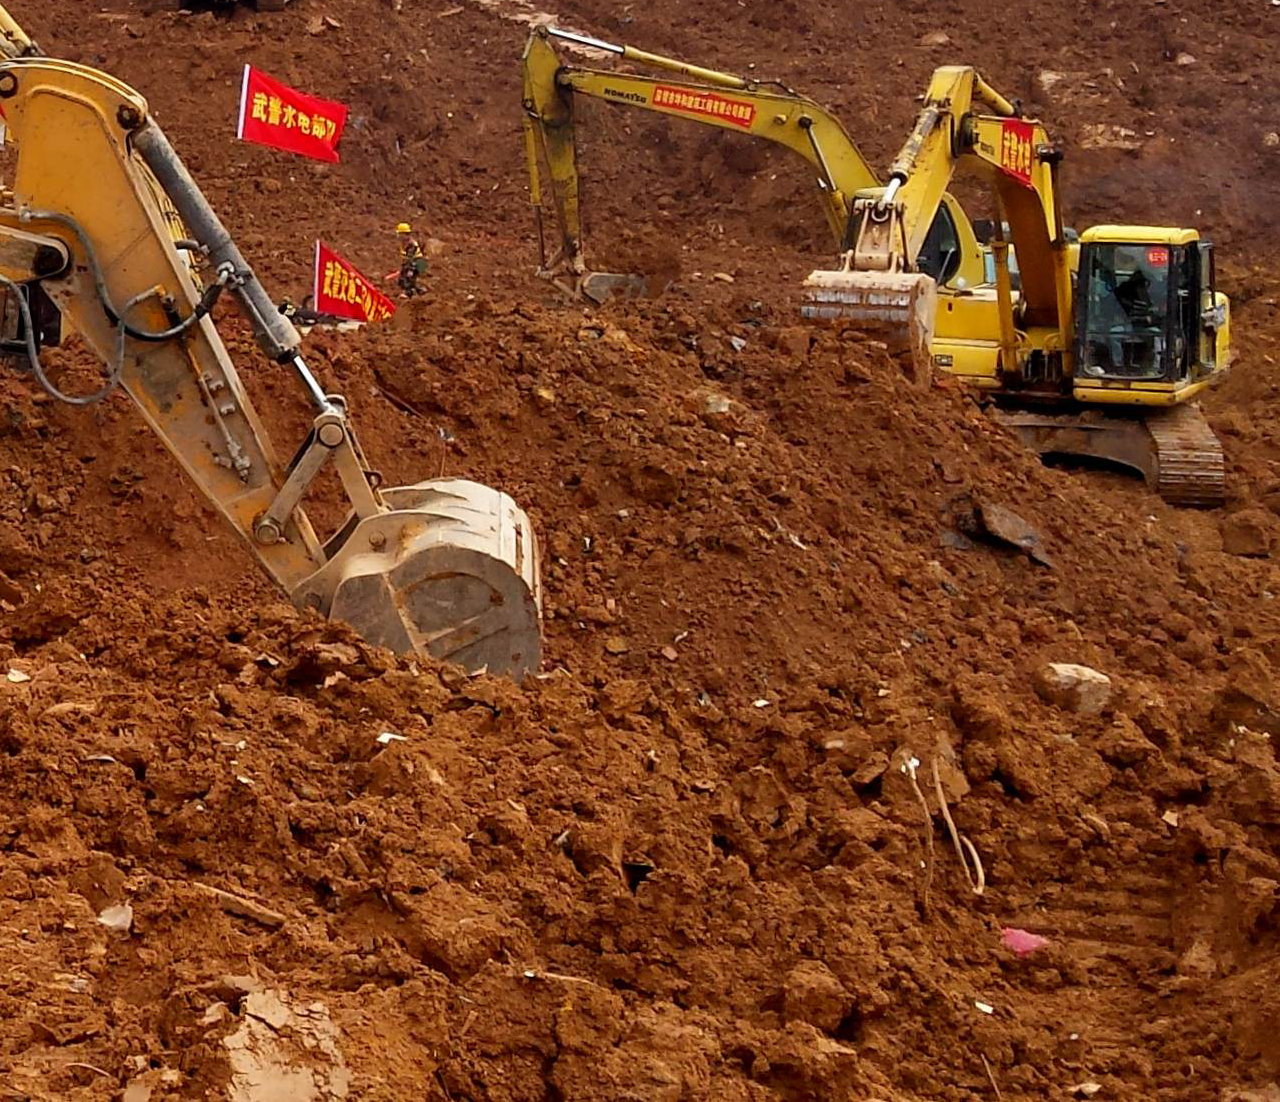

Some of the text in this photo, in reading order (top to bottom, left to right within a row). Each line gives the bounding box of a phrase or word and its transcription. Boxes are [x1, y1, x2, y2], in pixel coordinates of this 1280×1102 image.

[604, 88, 646, 104] KOMATSU
[1003, 130, 1031, 176] 武警水电
